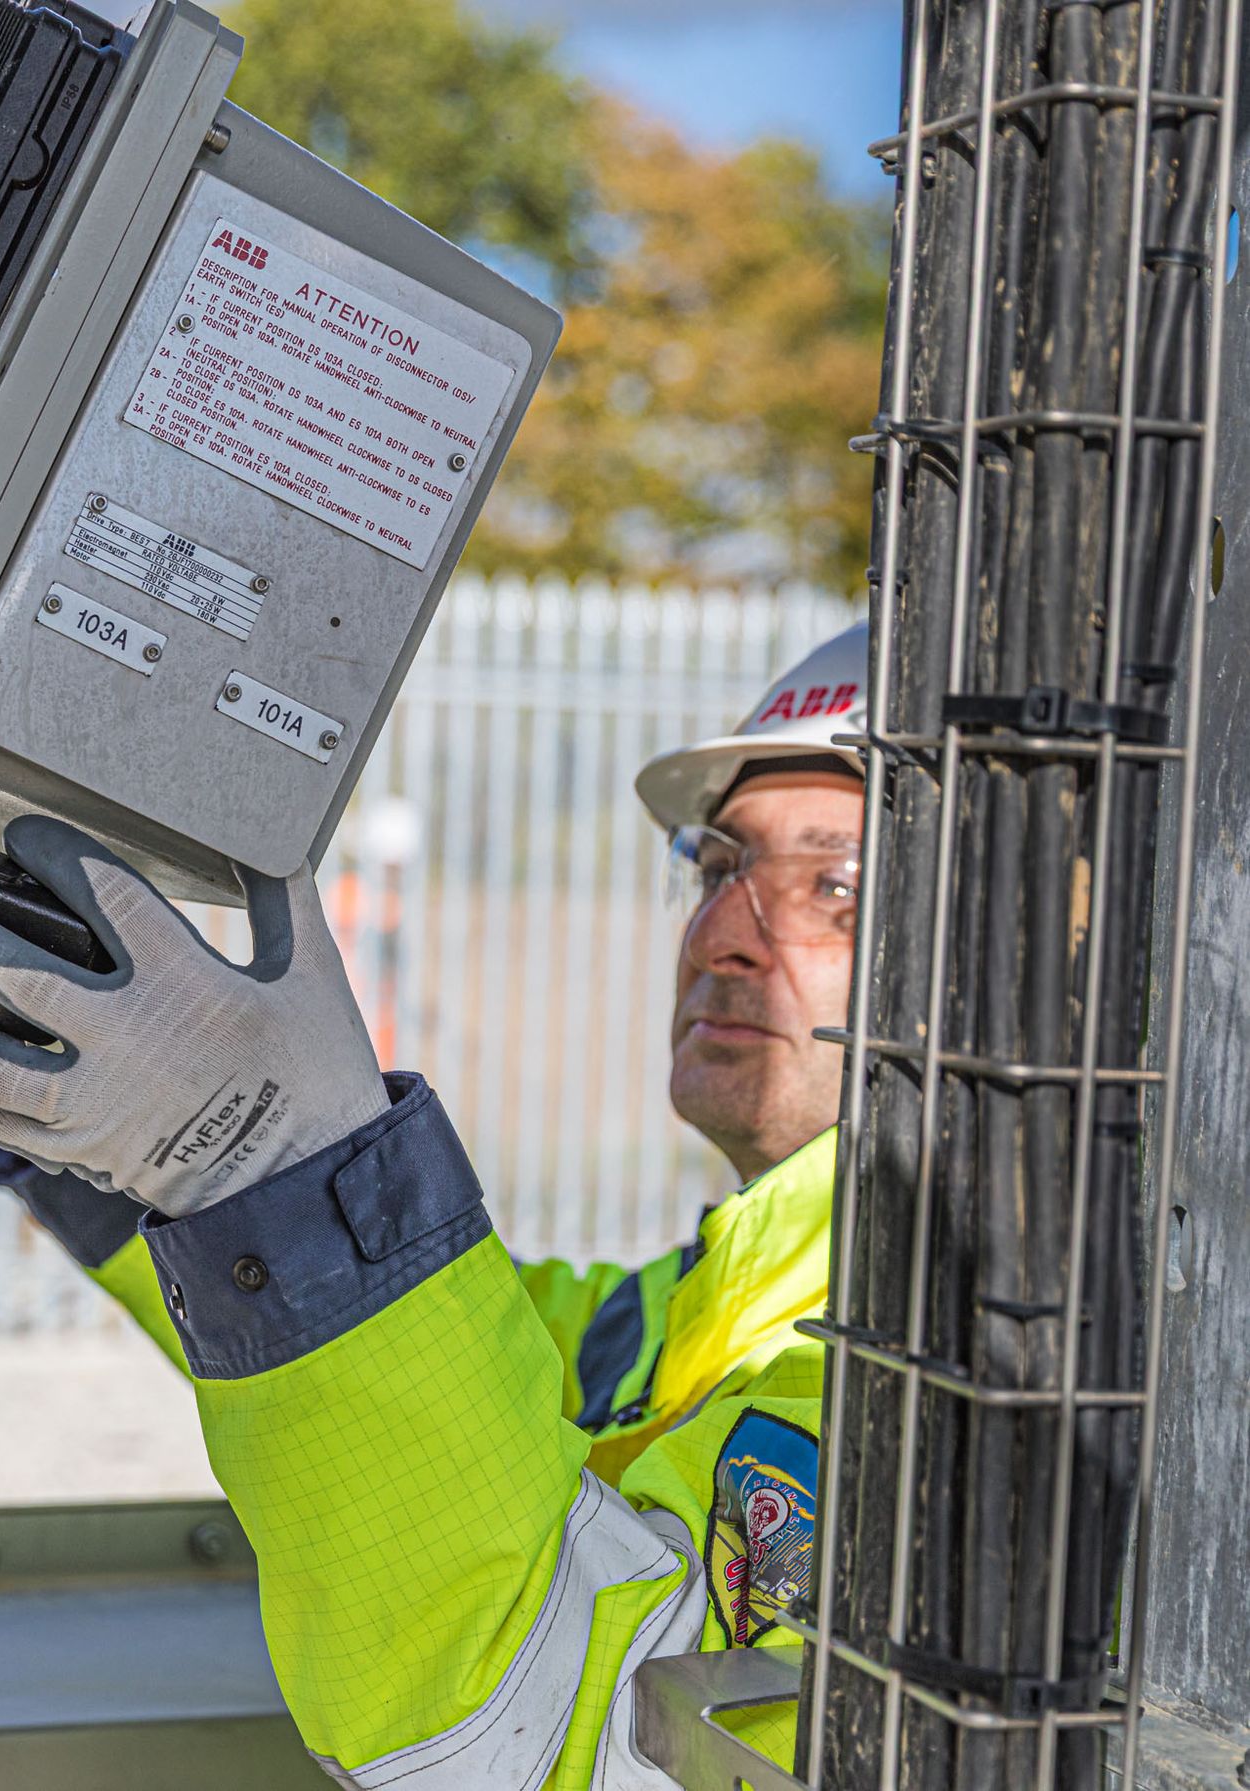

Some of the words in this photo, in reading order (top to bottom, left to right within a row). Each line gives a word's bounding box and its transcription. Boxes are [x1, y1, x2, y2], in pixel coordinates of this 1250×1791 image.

[211, 229, 269, 270] ABB
[196, 268, 226, 289] EARTH
[229, 284, 263, 308] SWITCH
[265, 303, 285, 319] (ES)
[201, 257, 258, 292] DESCRIPTION
[260, 288, 279, 303] FOR
[281, 298, 316, 324] MANUAL
[320, 318, 368, 349] OPERATION
[370, 345, 384, 356] OF
[385, 352, 449, 392] DISCONNECTOR
[209, 293, 221, 304] IF
[223, 300, 263, 326] CURRENT
[265, 322, 305, 348] POSITION
[307, 343, 321, 356] DS
[324, 352, 343, 368] 103A
[295, 283, 420, 356] ATTENTION
[186, 347, 227, 375] (NEUTRAL
[205, 303, 216, 315] TO
[218, 311, 241, 328] OPEN
[242, 323, 255, 335] DS
[281, 343, 312, 364] ROTATE
[314, 359, 360, 390] HANDWHEEL
[363, 386, 428, 424] ANTI-CLOCKWISE
[430, 419, 441, 431] TO
[443, 426, 476, 450] NEUTRAL
[166, 388, 198, 410] CLOSED
[190, 337, 201, 347] IF
[203, 343, 244, 369] CURRENT
[245, 365, 286, 392] POSITION
[288, 386, 301, 399] DS
[304, 395, 323, 412] 103A
[326, 407, 346, 422] AND
[348, 418, 362, 430] ES
[365, 426, 382, 442] 101A
[385, 436, 409, 455] BOTH
[411, 450, 435, 468] OPEN
[158, 402, 169, 413] IF
[171, 409, 213, 435] CURRENT
[214, 431, 255, 457] POSITION
[257, 452, 270, 465] ES
[273, 460, 291, 476] 101A
[171, 377, 182, 389] TO
[185, 385, 212, 404] CLOSE
[213, 399, 226, 411] ES
[252, 419, 284, 441] ROTATE
[285, 436, 334, 467] HANDWHEEL
[336, 462, 403, 502] ANTI-CLOCKWISE
[405, 497, 417, 508] TO
[418, 504, 431, 516] ES
[181, 357, 192, 369] TO
[194, 365, 221, 384] CLOSE
[223, 379, 236, 391] DS
[262, 399, 294, 421] ROTATE
[296, 416, 344, 447] HANDWHEEL
[347, 443, 393, 472] CLOCKWISE
[395, 466, 406, 478] TO
[407, 473, 420, 485] DS
[422, 481, 453, 502] CLOSED
[154, 413, 166, 425] TO
[168, 421, 191, 438] OPEN
[193, 433, 206, 445] ES
[231, 452, 263, 474] ROTATE
[265, 470, 313, 500] HANDWHEEL
[316, 496, 362, 524] CLOCKWISE
[364, 519, 375, 531] TO
[377, 526, 412, 551] NEUTRAL
[86, 511, 105, 525] Drive
[70, 547, 91, 561] Motor
[74, 538, 98, 554] Heater
[78, 528, 128, 558] Electromagnet
[141, 549, 165, 565] RATED
[162, 533, 196, 557] ABB
[76, 608, 129, 651] 103A
[257, 699, 303, 737] 101A
[758, 682, 859, 725] ABB
[173, 1091, 247, 1164] HyFlex
